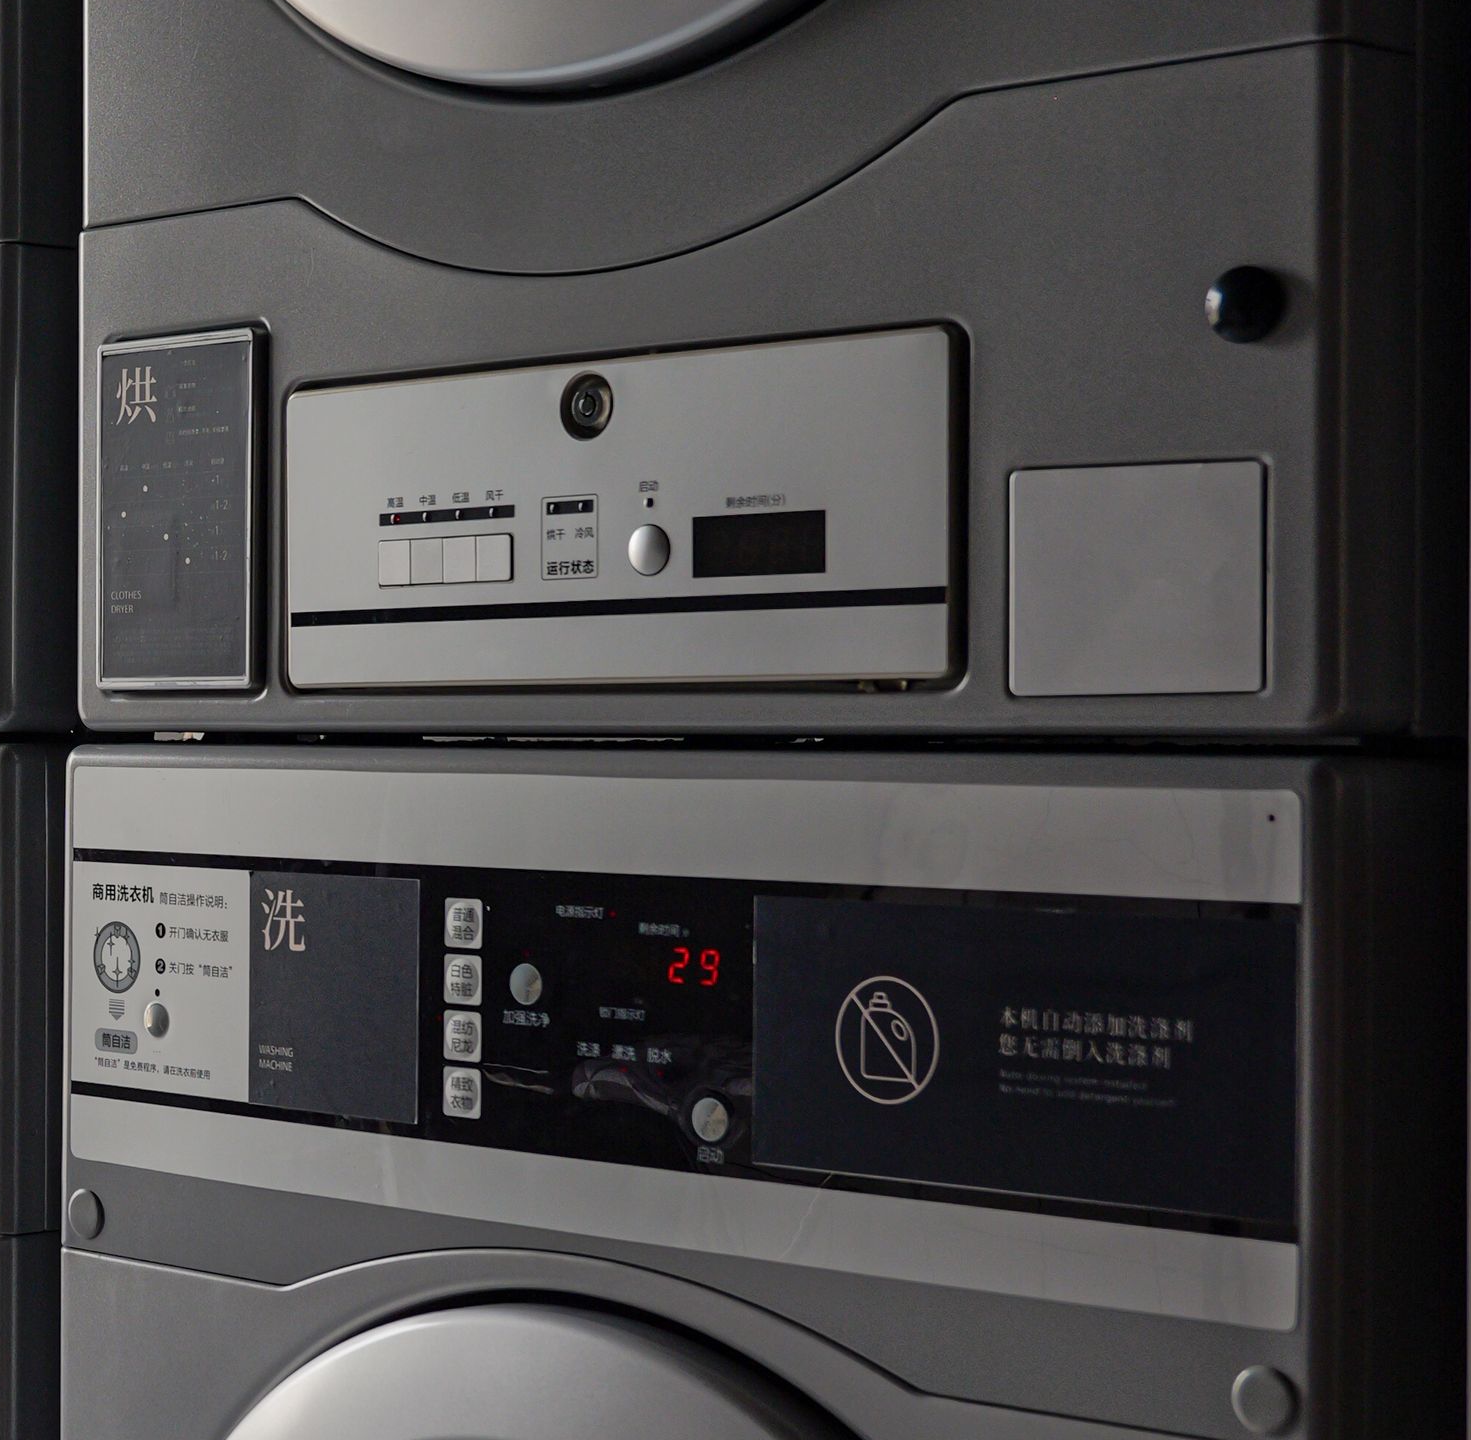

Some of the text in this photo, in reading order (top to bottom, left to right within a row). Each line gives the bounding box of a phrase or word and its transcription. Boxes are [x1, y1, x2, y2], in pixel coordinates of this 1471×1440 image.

[115, 365, 158, 427] 烘
[419, 494, 437, 506] 中温
[485, 489, 504, 501] 风干
[546, 559, 595, 576] 运行状态
[110, 590, 142, 600] CLOTHES
[110, 604, 135, 614] DRYER
[92, 883, 155, 905] 商用洗衣机
[261, 887, 306, 952] 洗
[169, 926, 229, 943] 开门确认无衣服
[451, 964, 473, 979] 白色
[666, 946, 721, 987] 29
[1000, 1006, 1195, 1044] 本机自动添加洗涤剂
[258, 1045, 294, 1058] WASHING
[450, 1039, 474, 1054] 尼龙
[998, 1032, 1172, 1070] 您无需倒入洗涤剂
[646, 1047, 673, 1064] 脱水
[258, 1059, 294, 1073] MACHINE
